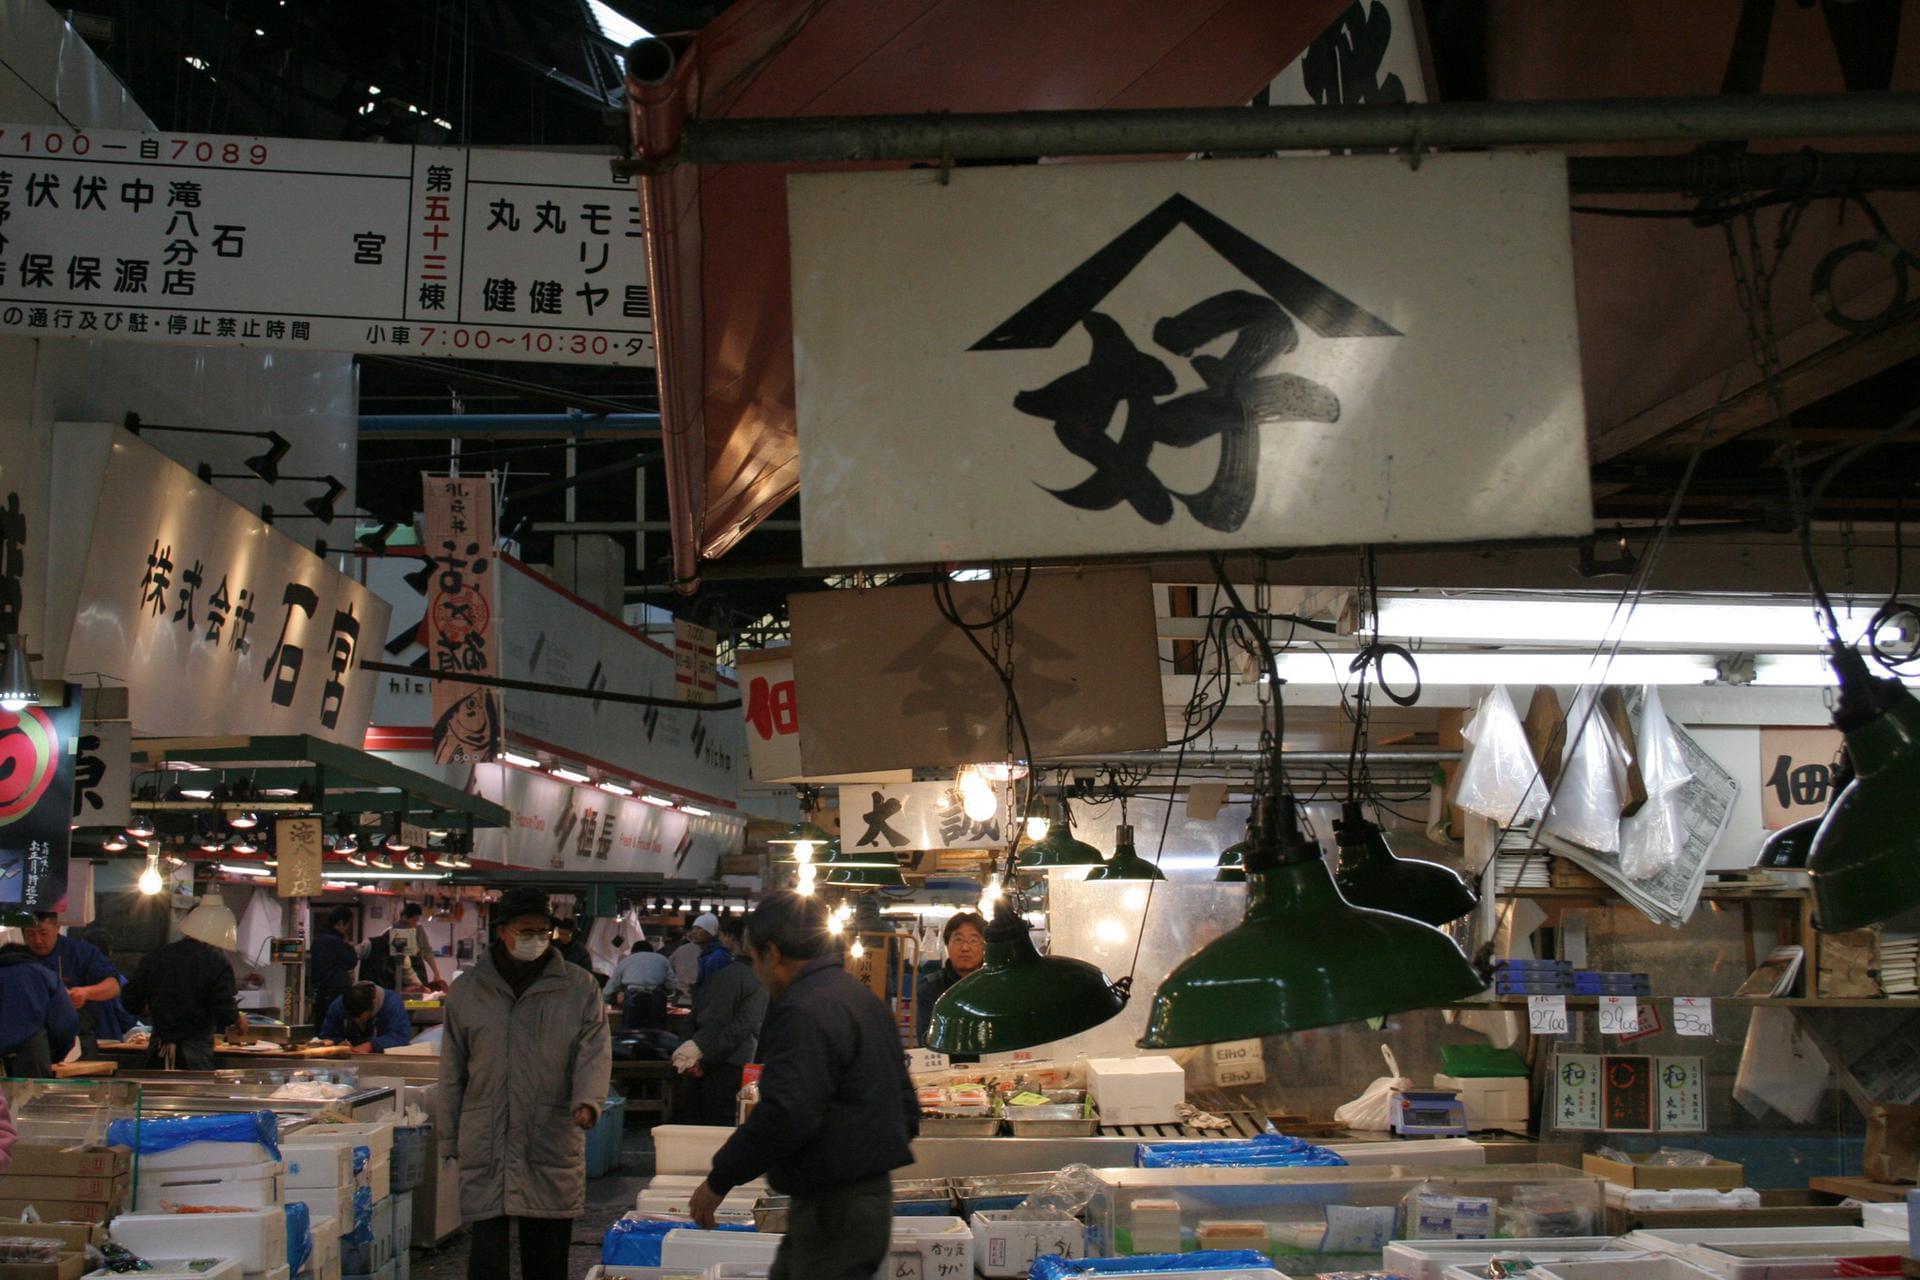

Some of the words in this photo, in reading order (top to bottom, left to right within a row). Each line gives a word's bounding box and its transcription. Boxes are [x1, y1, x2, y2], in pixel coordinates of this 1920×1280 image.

[162, 181, 202, 295] 滝八分店
[419, 164, 453, 310] 第五十三棟
[576, 204, 611, 316] モリヤ
[1013, 289, 1340, 532] 好
